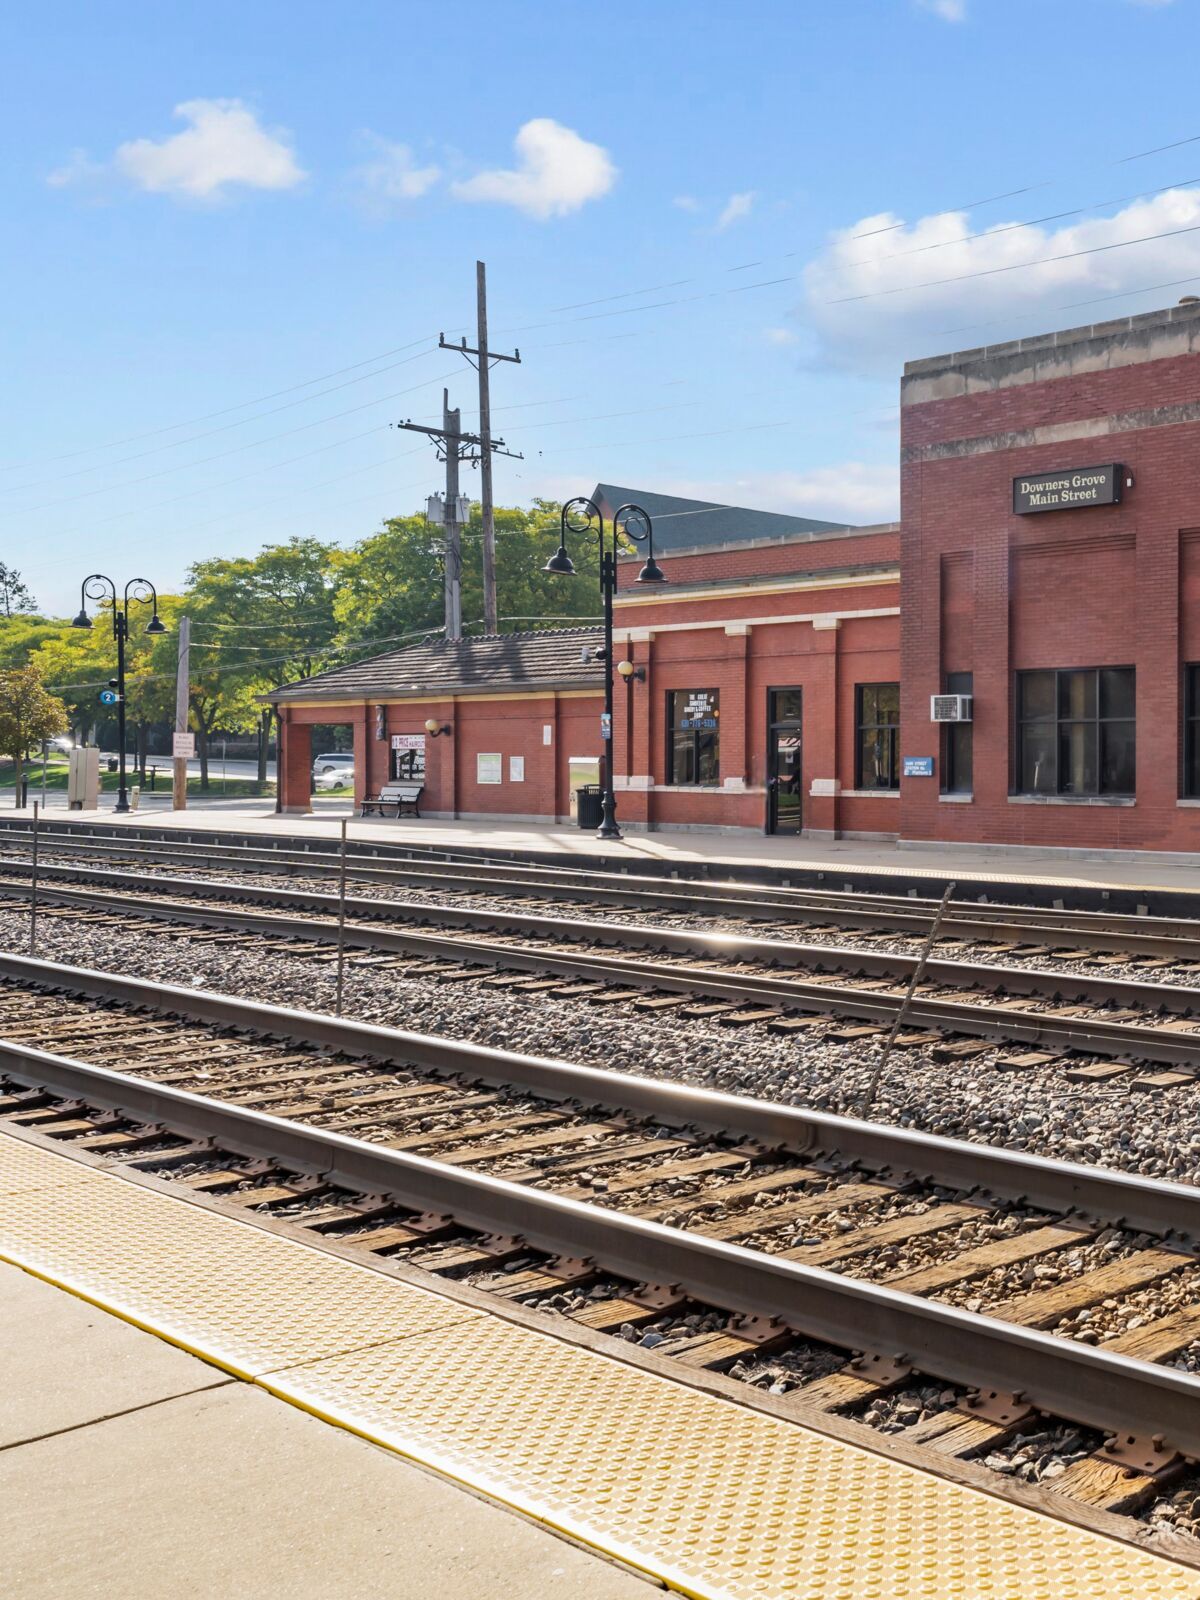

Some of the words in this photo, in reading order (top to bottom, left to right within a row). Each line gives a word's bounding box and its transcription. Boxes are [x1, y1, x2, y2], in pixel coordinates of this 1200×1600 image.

[1021, 479, 1070, 494] Downers
[1072, 475, 1106, 488] Grove
[1029, 492, 1059, 506] Main
[1061, 488, 1097, 502] Street
[105, 694, 111, 702] 2
